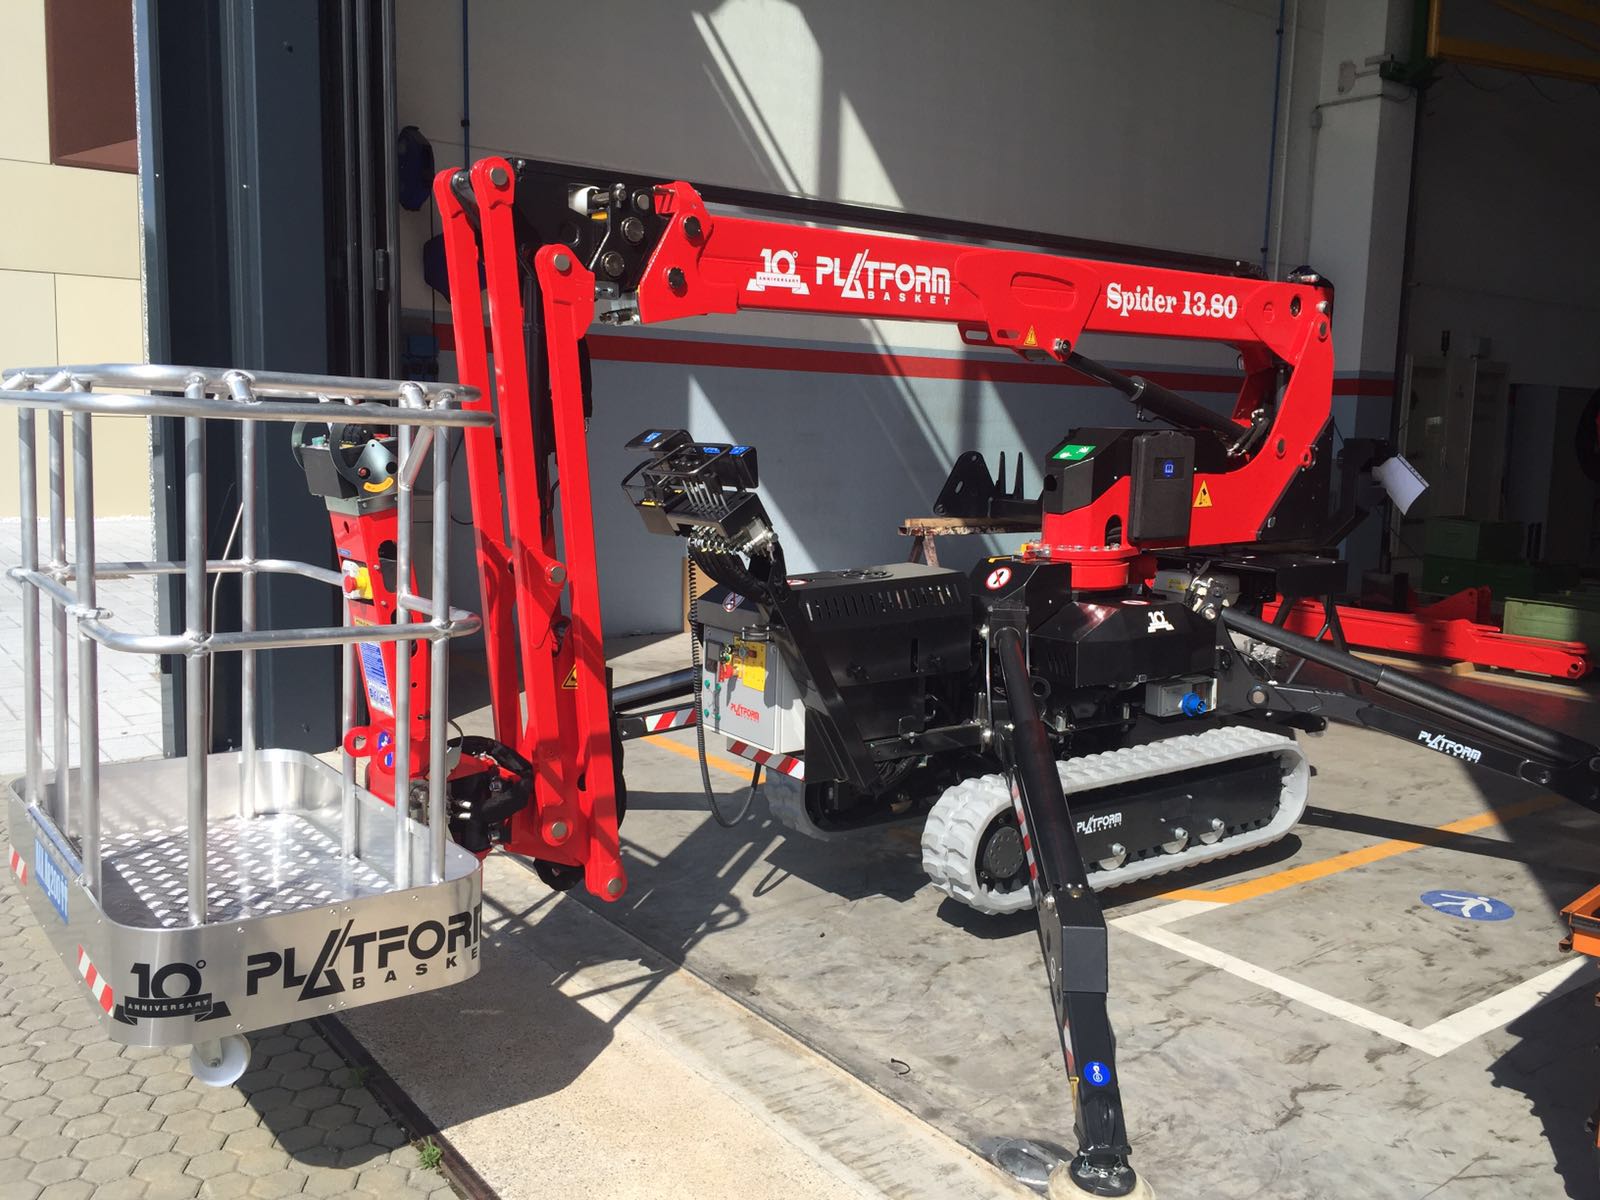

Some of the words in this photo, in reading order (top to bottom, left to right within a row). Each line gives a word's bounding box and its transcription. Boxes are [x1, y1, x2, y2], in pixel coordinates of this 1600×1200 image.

[816, 249, 950, 299] PLATFORM
[867, 292, 950, 305] BASKET
[1106, 282, 1177, 317] Spider
[1182, 290, 1238, 320] 13.80
[1418, 730, 1482, 762] PLATFORM
[1076, 812, 1122, 835] PLATFORM
[352, 946, 479, 990] BASKE
[127, 1000, 210, 1012] ANNIVERSARY
